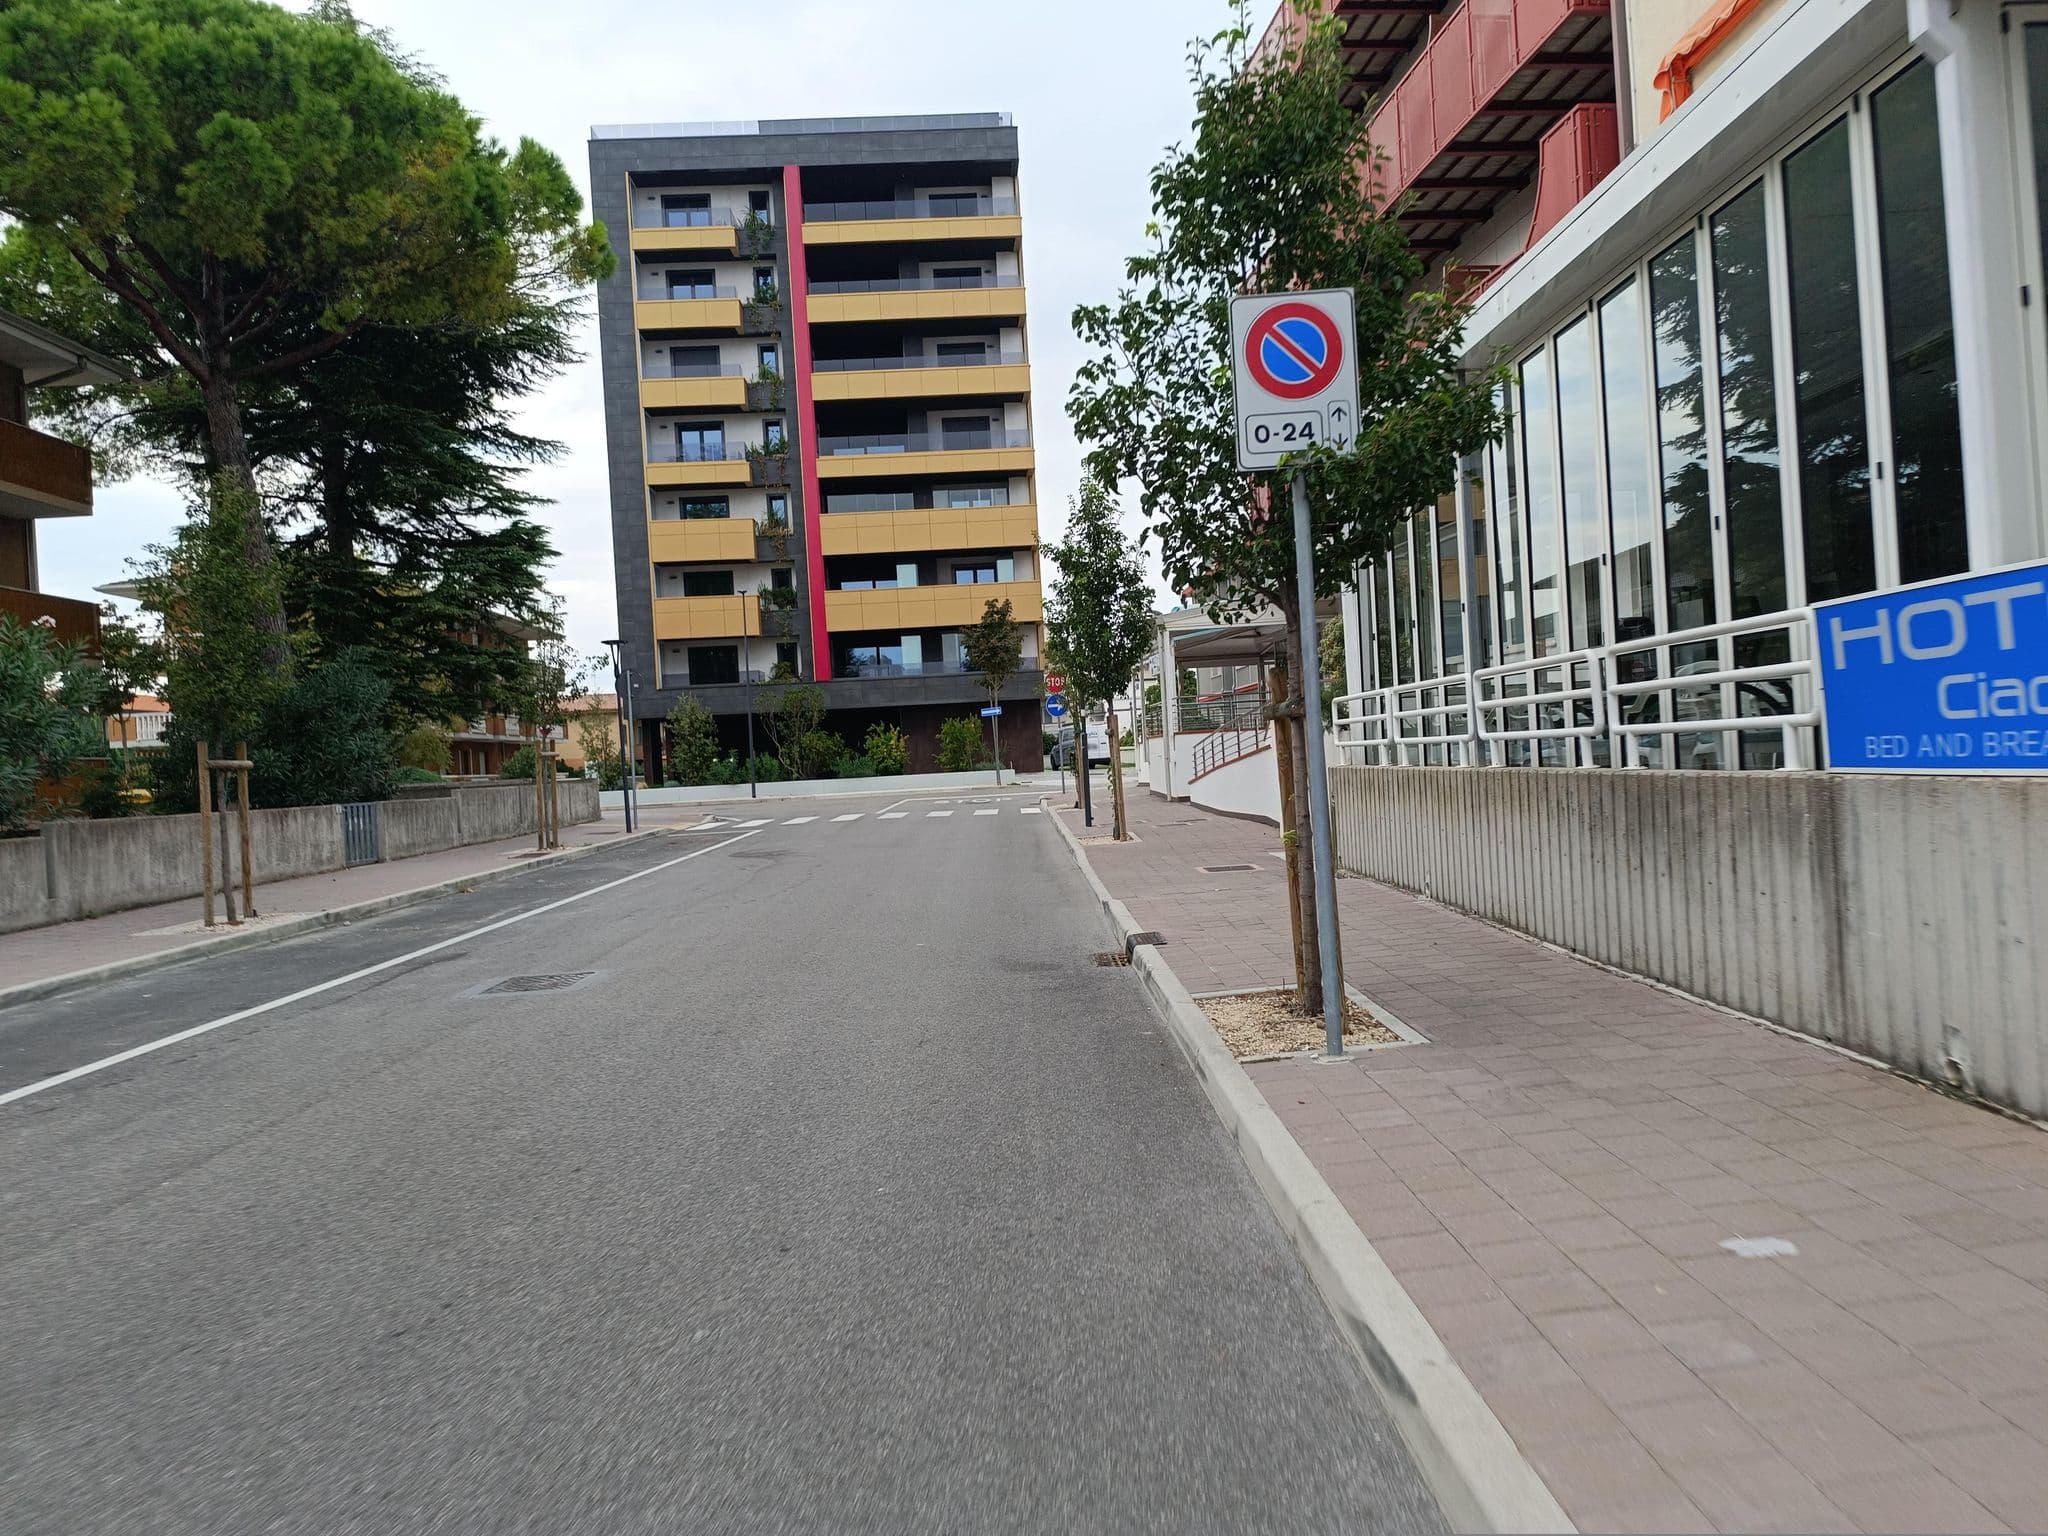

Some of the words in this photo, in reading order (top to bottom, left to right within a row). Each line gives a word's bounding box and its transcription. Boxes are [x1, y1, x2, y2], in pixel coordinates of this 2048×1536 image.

[1254, 421, 1315, 443] 0-24
[1829, 581, 2048, 670] HOT
[1046, 676, 1065, 687] STOP
[1865, 735, 1909, 758] BED
[1917, 733, 1973, 757] AND
